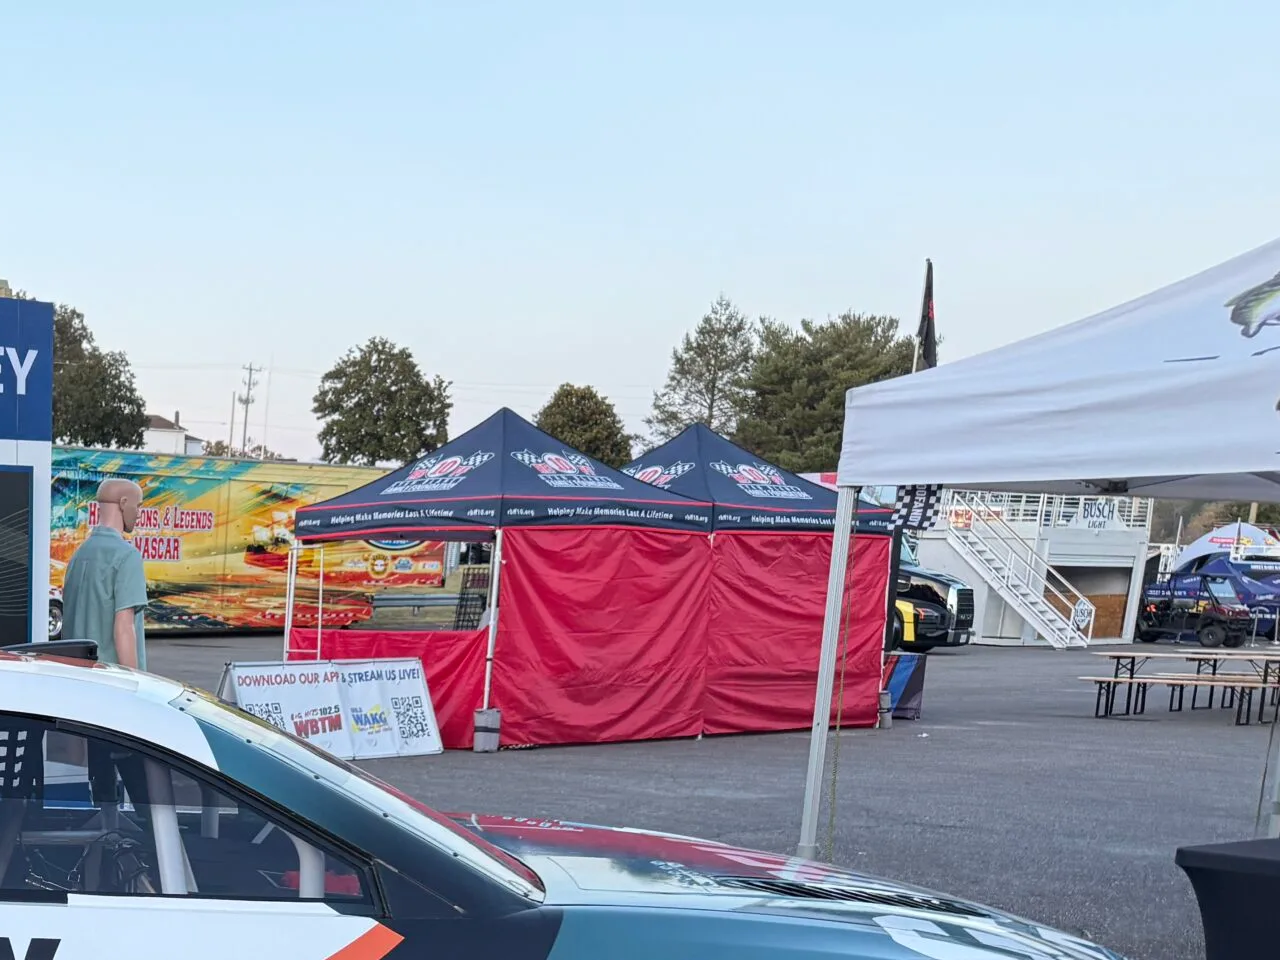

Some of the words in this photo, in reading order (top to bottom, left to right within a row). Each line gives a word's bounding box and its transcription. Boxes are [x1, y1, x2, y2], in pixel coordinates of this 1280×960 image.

[547, 507, 574, 517] Helping
[575, 507, 592, 516] Make
[593, 507, 625, 517] Memories
[626, 508, 639, 517] Last
[646, 509, 674, 519] Lifetime
[907, 484, 926, 527] OOFANDY
[1083, 501, 1115, 520] BUSCH
[174, 506, 213, 529] LEGENDS
[331, 515, 354, 525] Helping
[355, 514, 372, 522] Make
[373, 511, 404, 520] Memories
[426, 509, 454, 517] Lifetime
[751, 514, 774, 526] Helping
[775, 515, 790, 524] Make
[791, 515, 819, 525] Memories
[1087, 520, 1107, 529] LIGHT
[237, 673, 296, 687] DOWNLOAD
[299, 673, 320, 685] OUR
[348, 670, 384, 684] STREAM
[385, 670, 396, 681] US
[398, 669, 421, 680] LIVE!
[319, 705, 340, 716] 102.5
[352, 711, 387, 726] WAKG
[294, 713, 343, 739] WBTM
